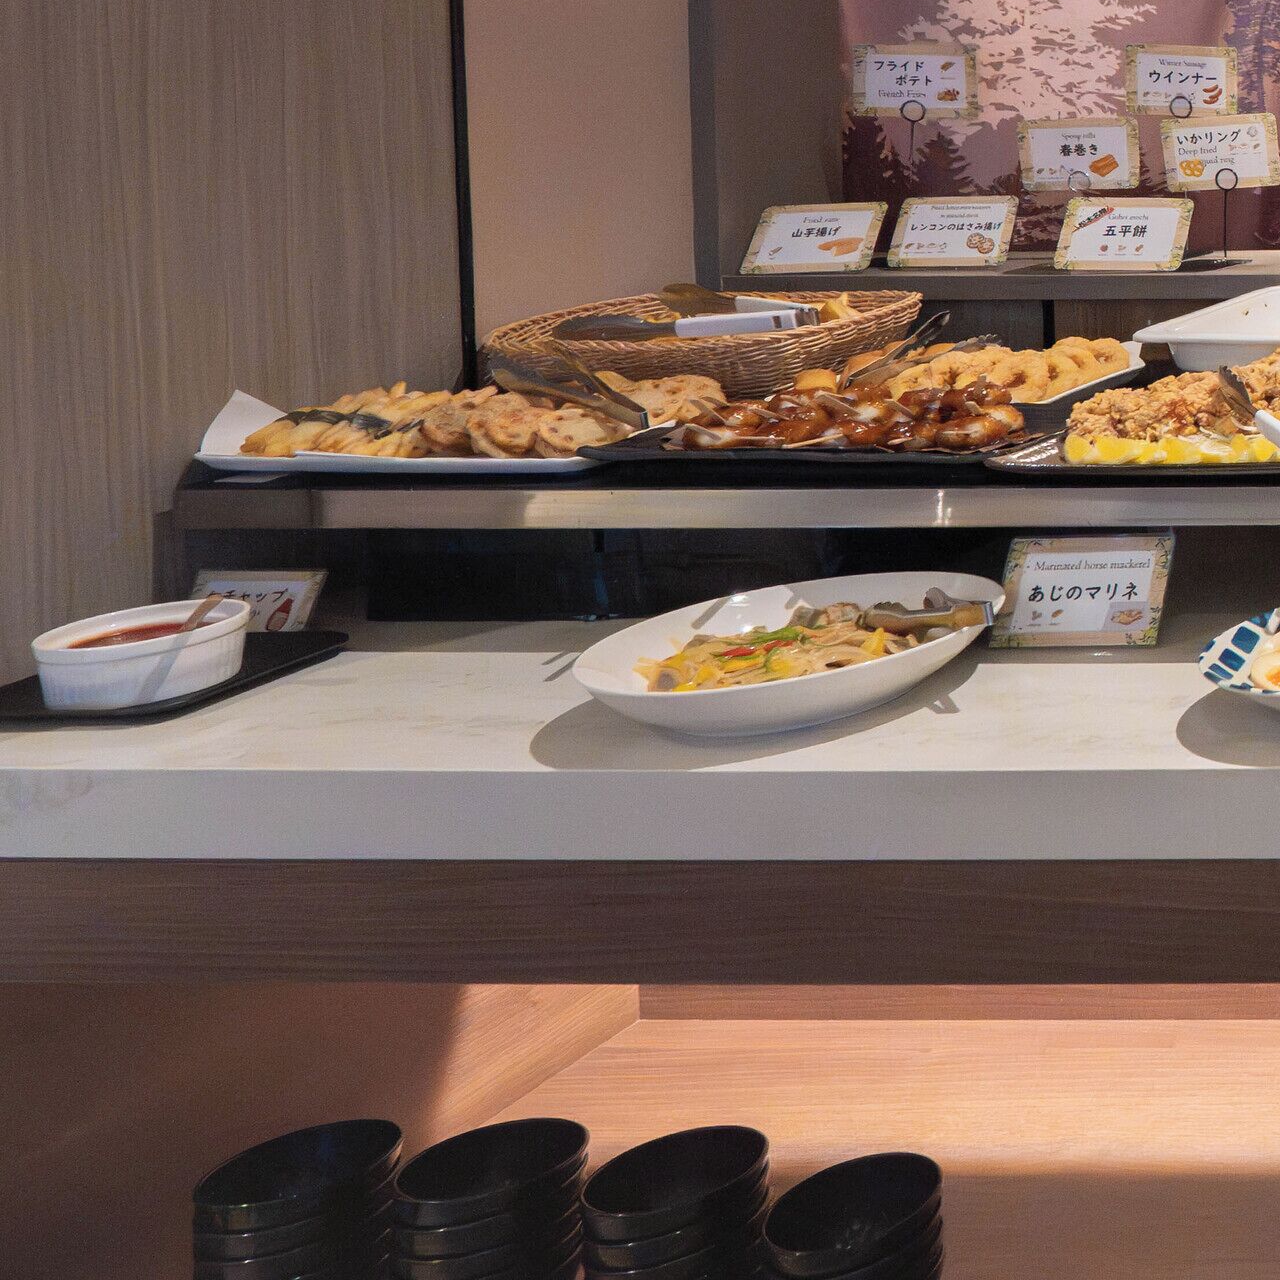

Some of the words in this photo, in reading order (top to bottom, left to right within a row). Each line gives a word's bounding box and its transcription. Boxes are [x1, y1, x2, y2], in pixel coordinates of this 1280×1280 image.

[874, 61, 924, 72] フライド
[895, 74, 932, 86] ポテト
[1149, 69, 1217, 84] ウインナー
[1177, 128, 1241, 145] いかリング
[1060, 143, 1098, 157] 春巻き
[791, 226, 842, 238] 山芋揚げ
[911, 221, 1003, 231] レンコンのはさみ揚げ
[1102, 225, 1148, 237] 五平餅
[1034, 560, 1081, 571] Marinated
[1084, 560, 1108, 570] horse
[1028, 582, 1139, 602] あじのマリネ
